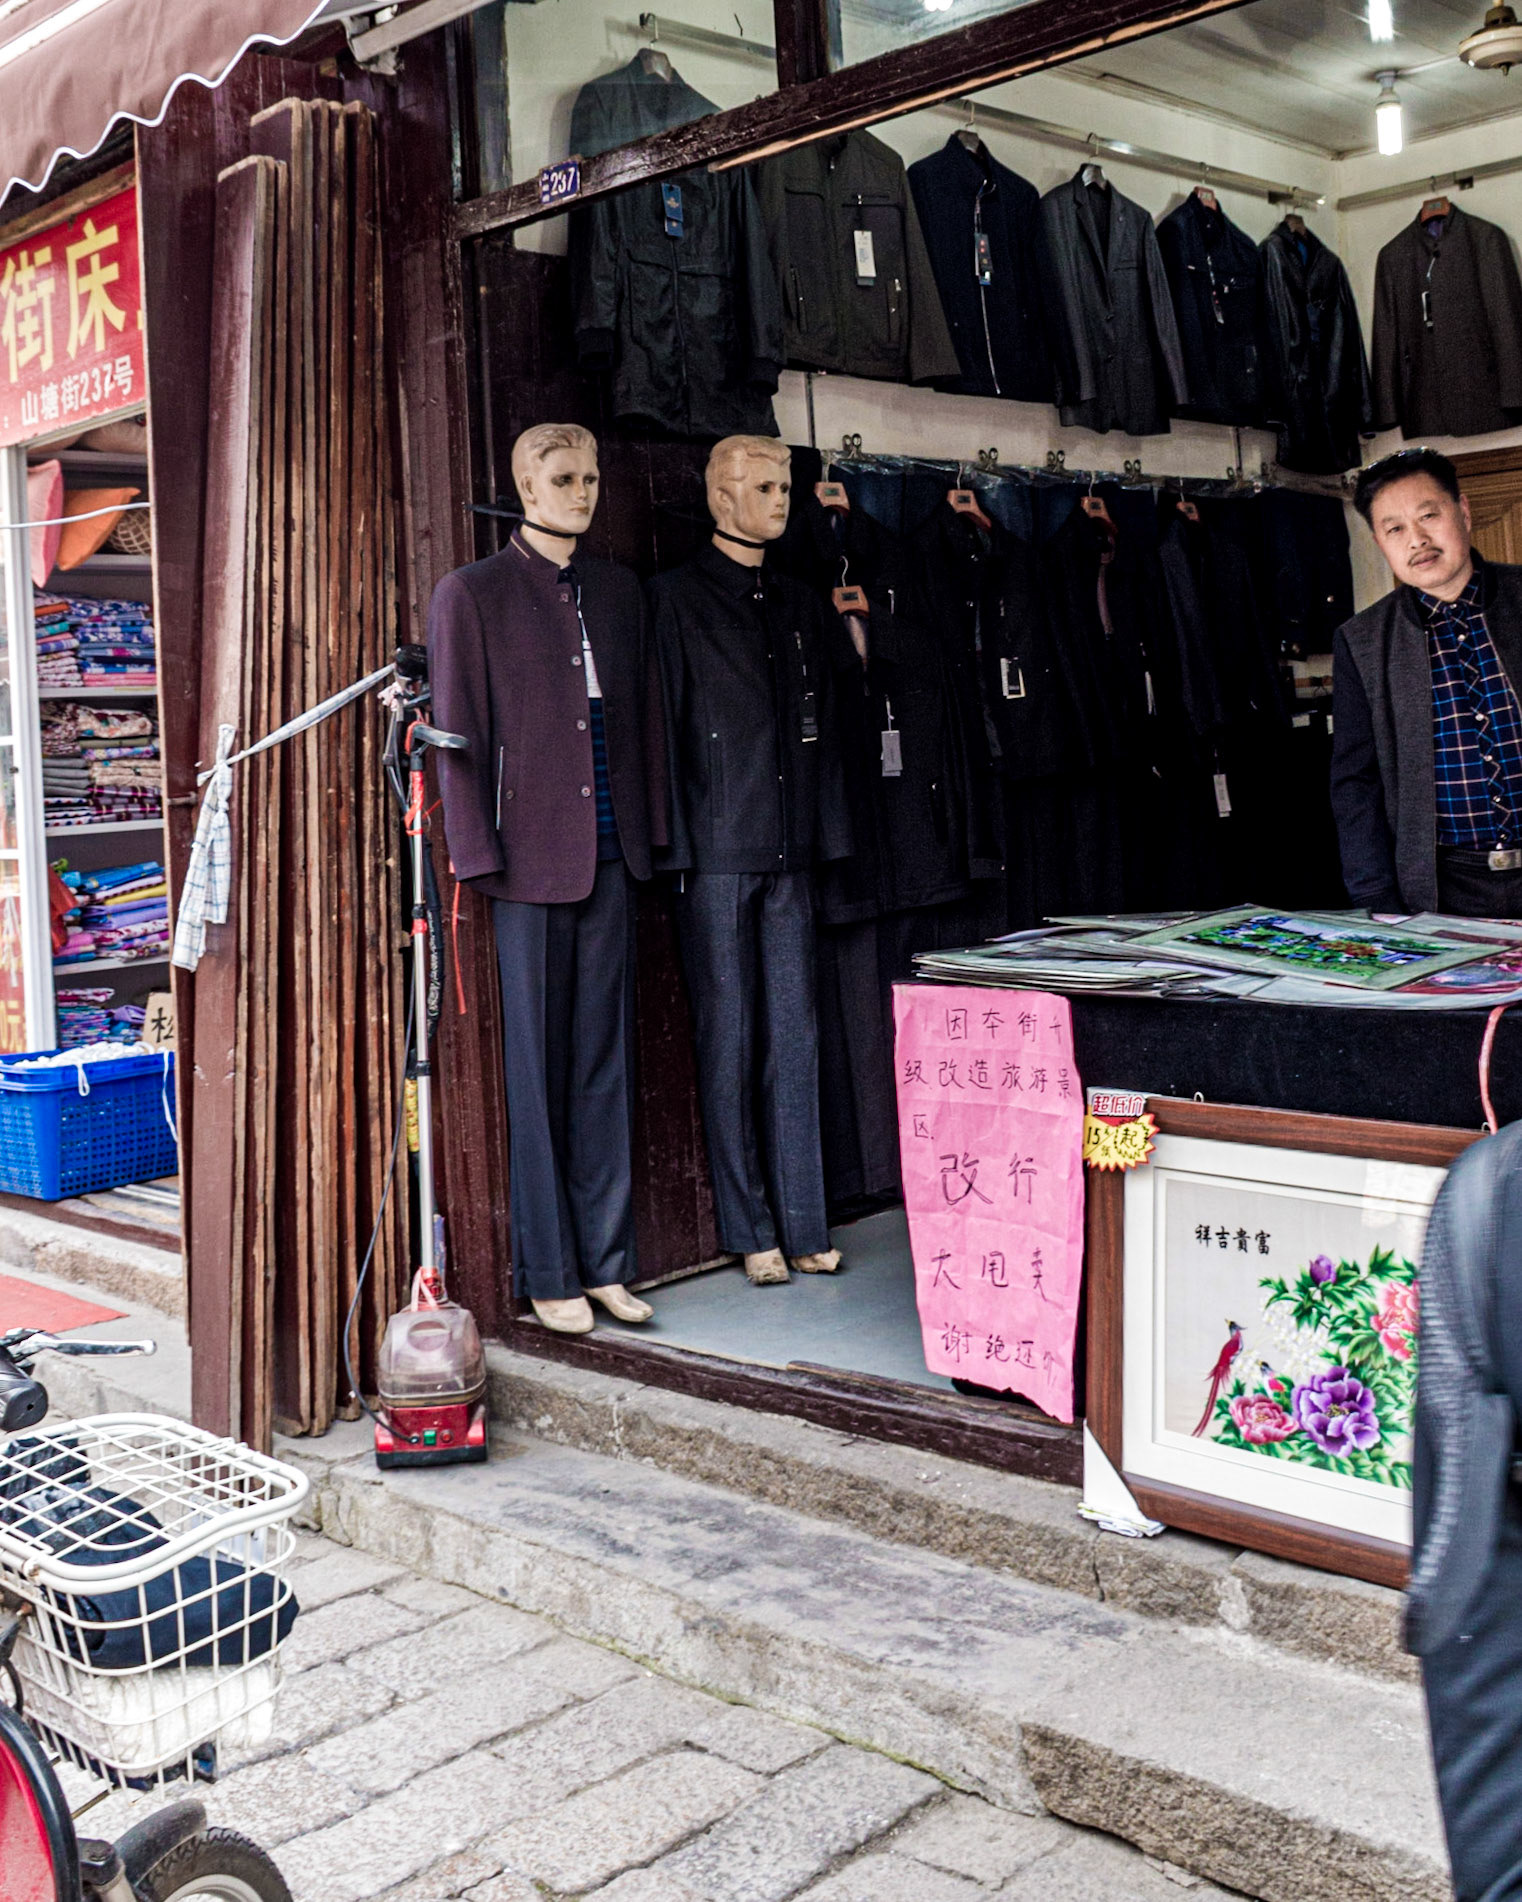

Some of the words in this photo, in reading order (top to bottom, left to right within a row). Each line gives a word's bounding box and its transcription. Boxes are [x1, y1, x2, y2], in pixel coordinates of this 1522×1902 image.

[550, 167, 576, 196] 237
[0, 218, 143, 384] 街床
[904, 1060, 1072, 1098] 级改造旅游景
[1093, 1094, 1146, 1116] 超低价
[940, 1152, 1038, 1204] 改行
[931, 1247, 1050, 1302] 大甩卖
[940, 1322, 1057, 1386] 谢绝还价
